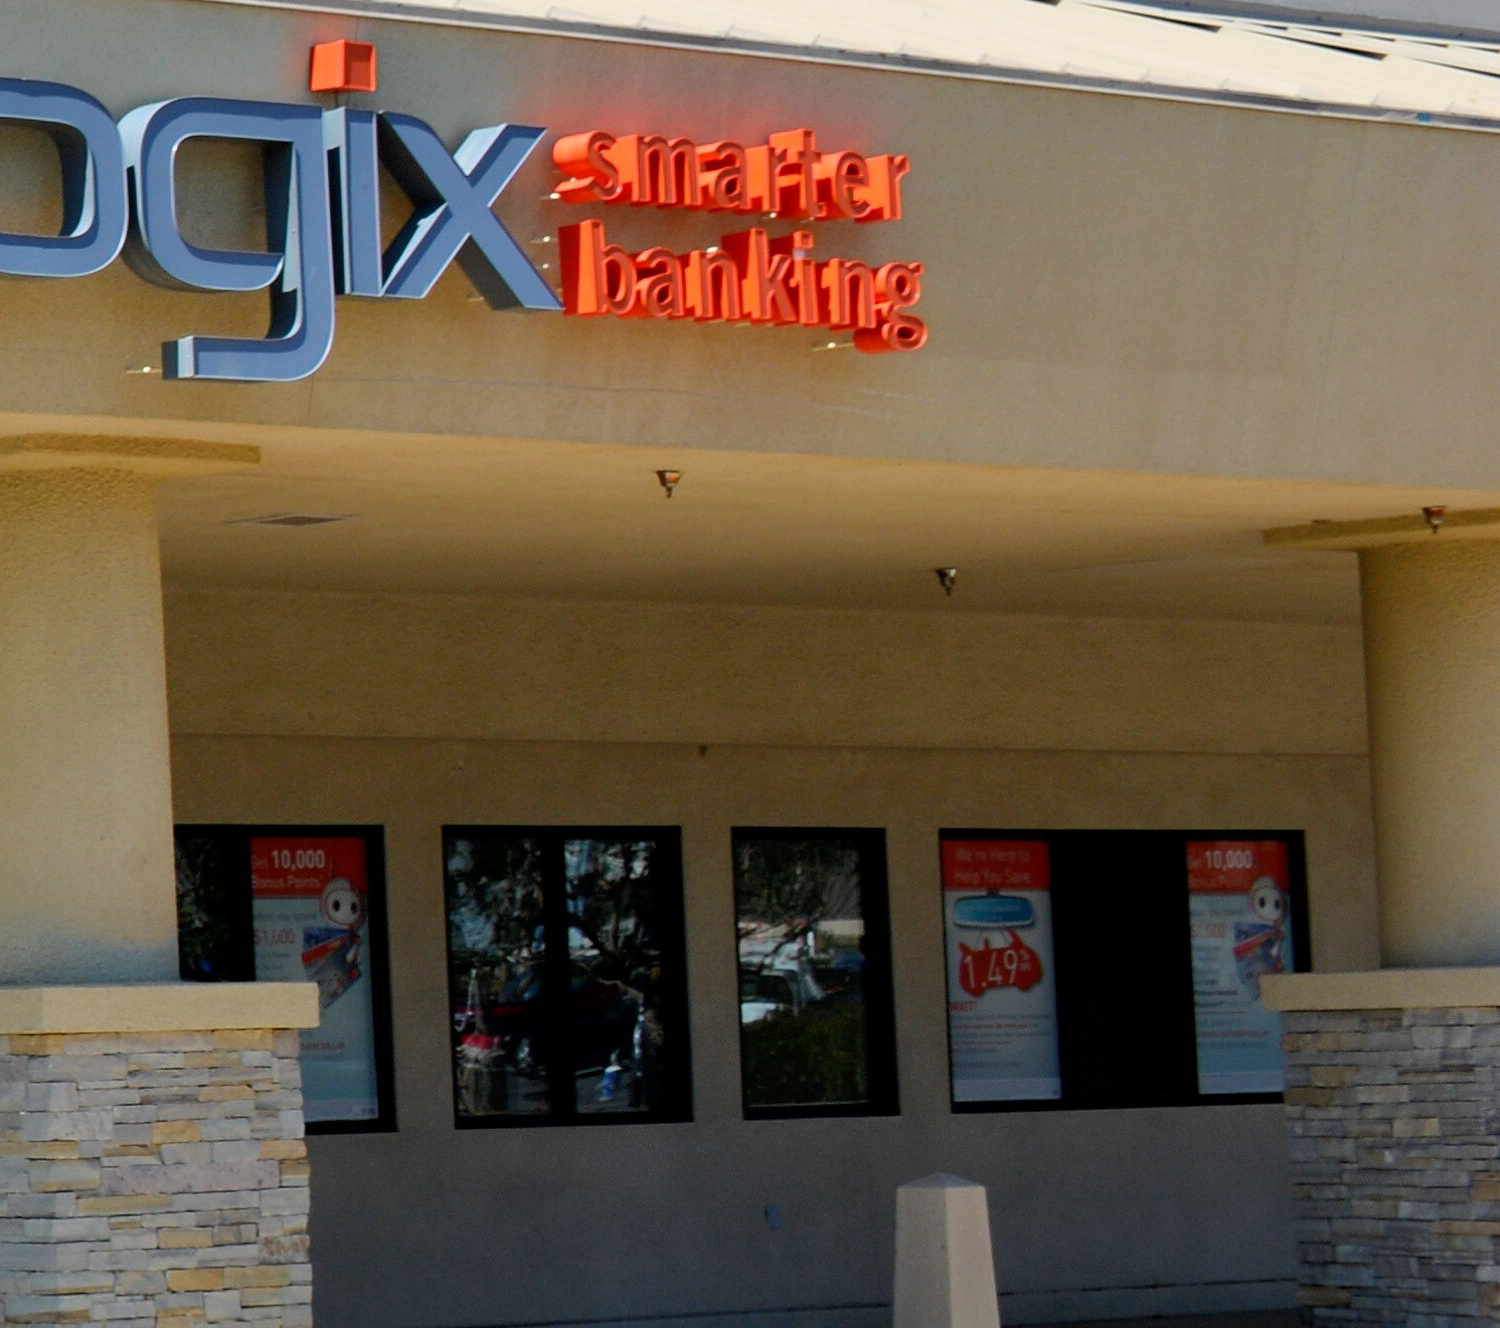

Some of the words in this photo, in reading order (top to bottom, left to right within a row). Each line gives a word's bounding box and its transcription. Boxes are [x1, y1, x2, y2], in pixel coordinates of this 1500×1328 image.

[553, 129, 910, 222] smarter
[561, 218, 928, 353] banking
[271, 849, 326, 872] 10,000
[1205, 849, 1253, 872] 10,000
[963, 948, 1019, 990] 1.49
